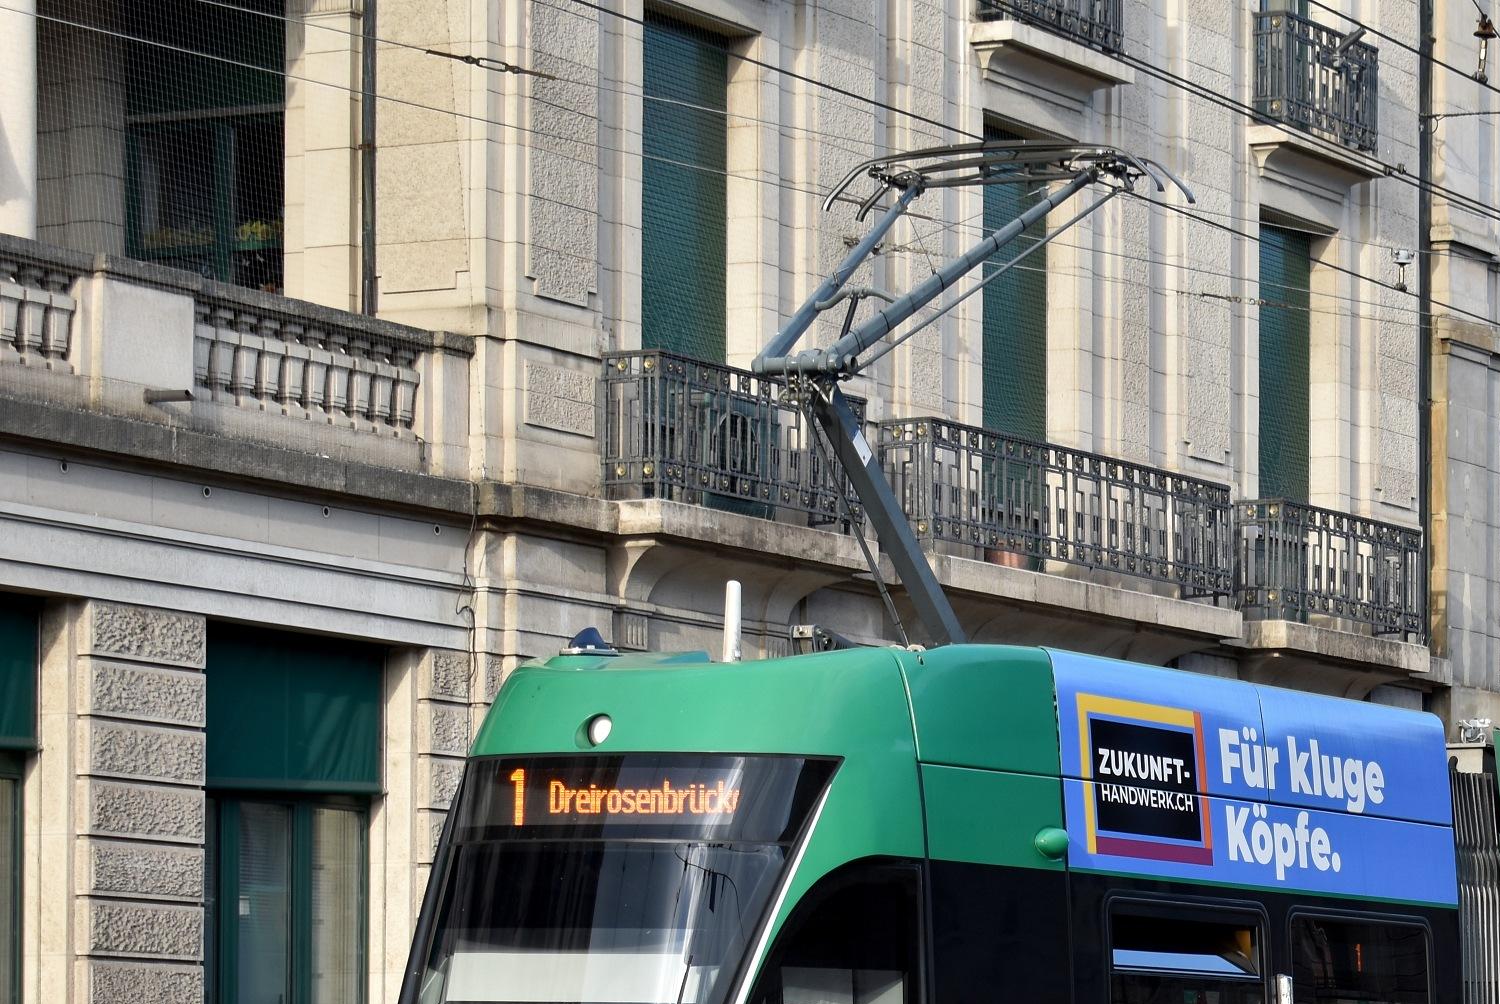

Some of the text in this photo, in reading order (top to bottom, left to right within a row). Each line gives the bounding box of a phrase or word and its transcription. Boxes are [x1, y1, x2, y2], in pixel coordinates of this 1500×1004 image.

[1098, 747, 1191, 785] ZUKUNFT-
[1218, 725, 1385, 814] Für kluge
[510, 768, 525, 827] 1
[1100, 784, 1195, 813] HANDWERK.CH
[1225, 803, 1342, 881] Köpfe.
